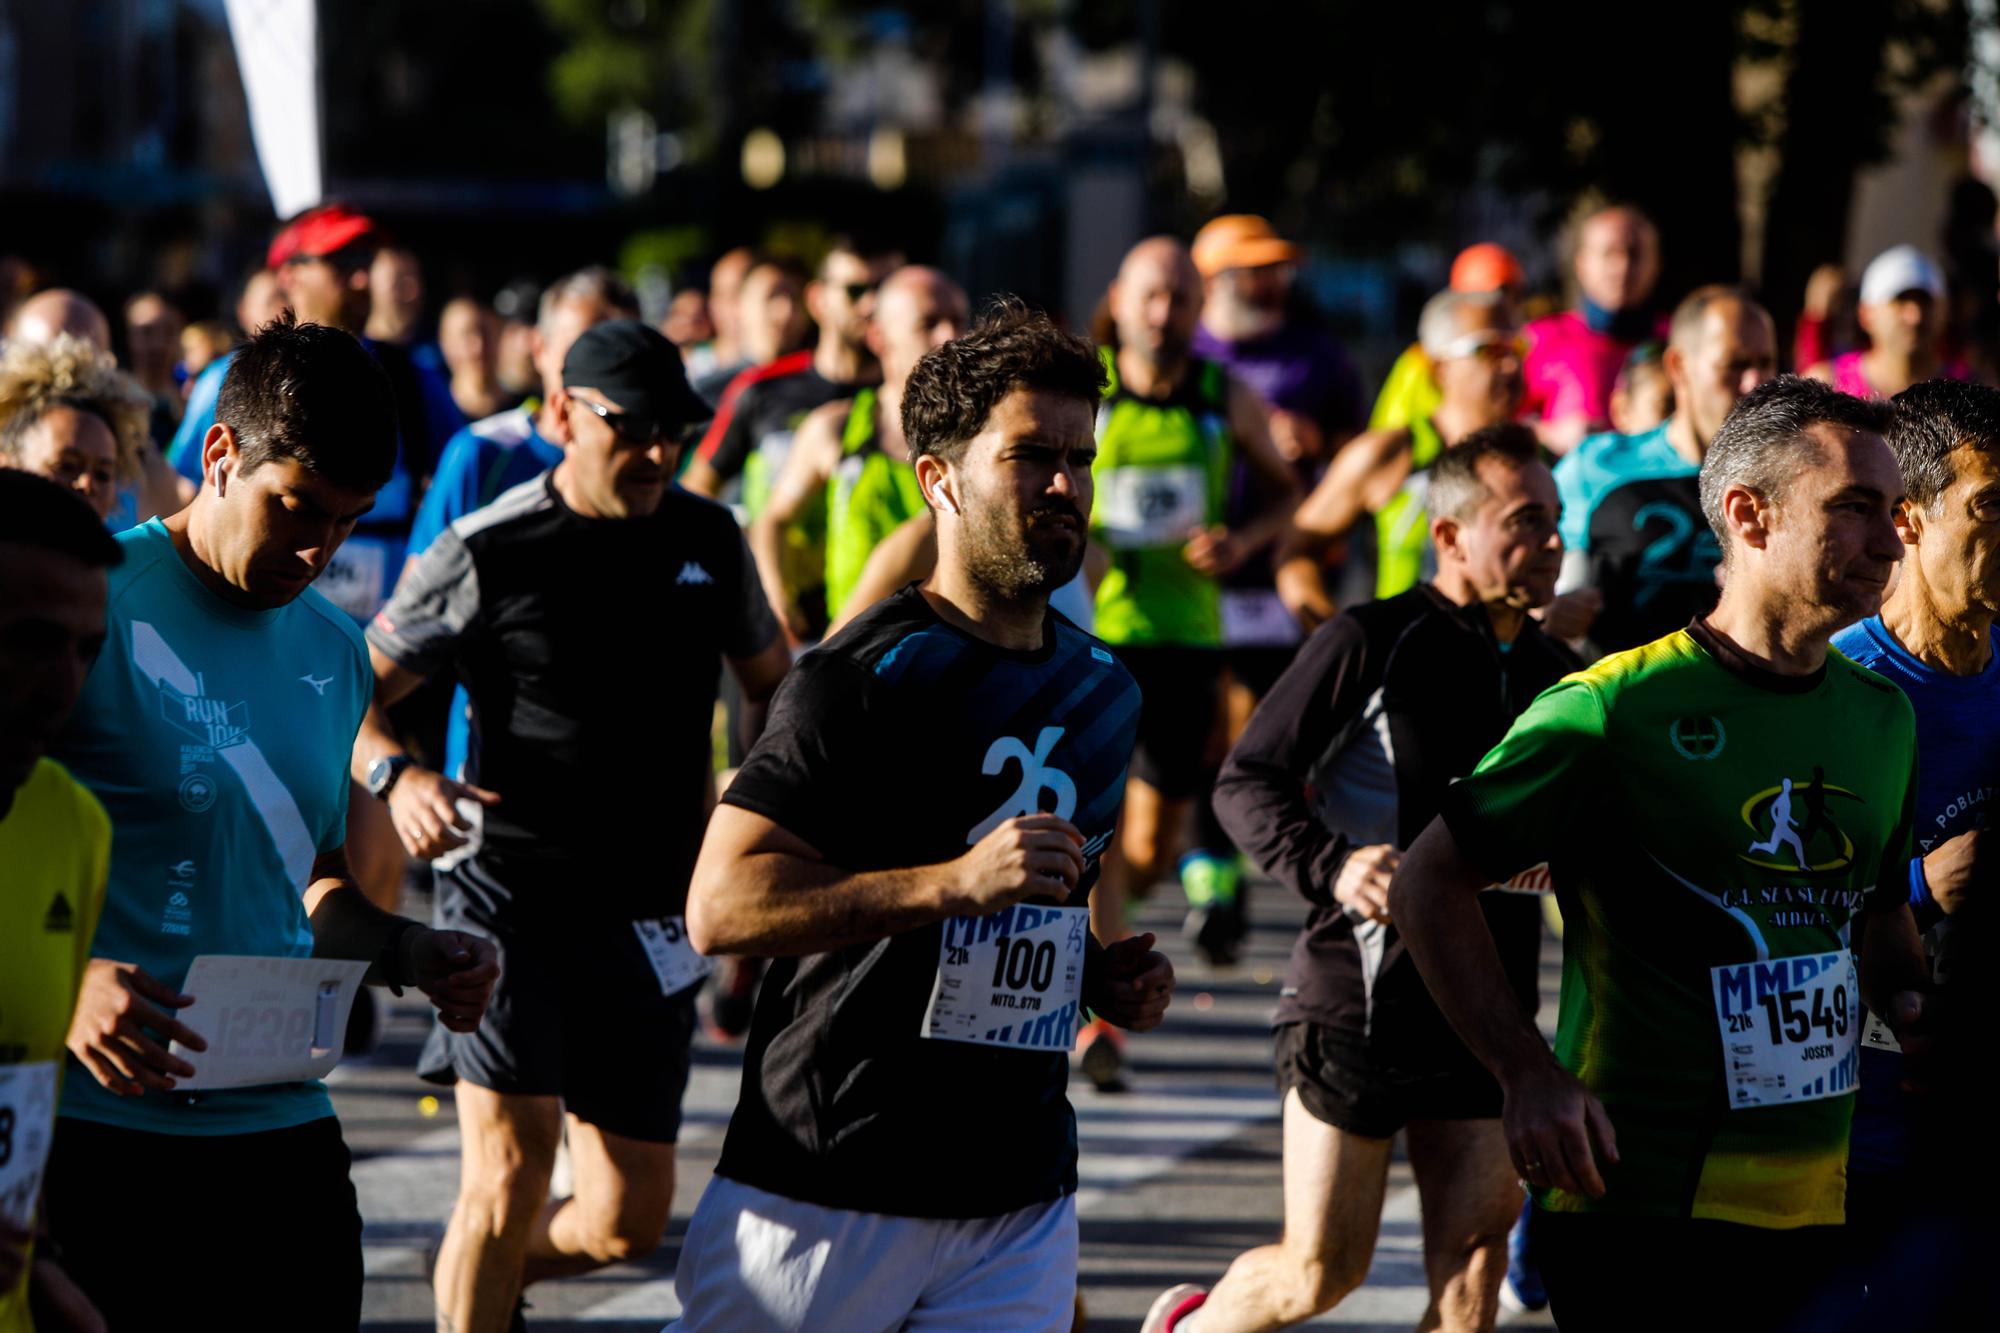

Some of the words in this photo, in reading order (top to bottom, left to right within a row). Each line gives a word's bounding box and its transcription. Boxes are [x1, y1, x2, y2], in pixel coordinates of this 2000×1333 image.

[197, 672, 205, 696] I
[184, 696, 229, 725] RUN
[992, 937, 1056, 992] 100
[1760, 984, 1848, 1045] 1549
